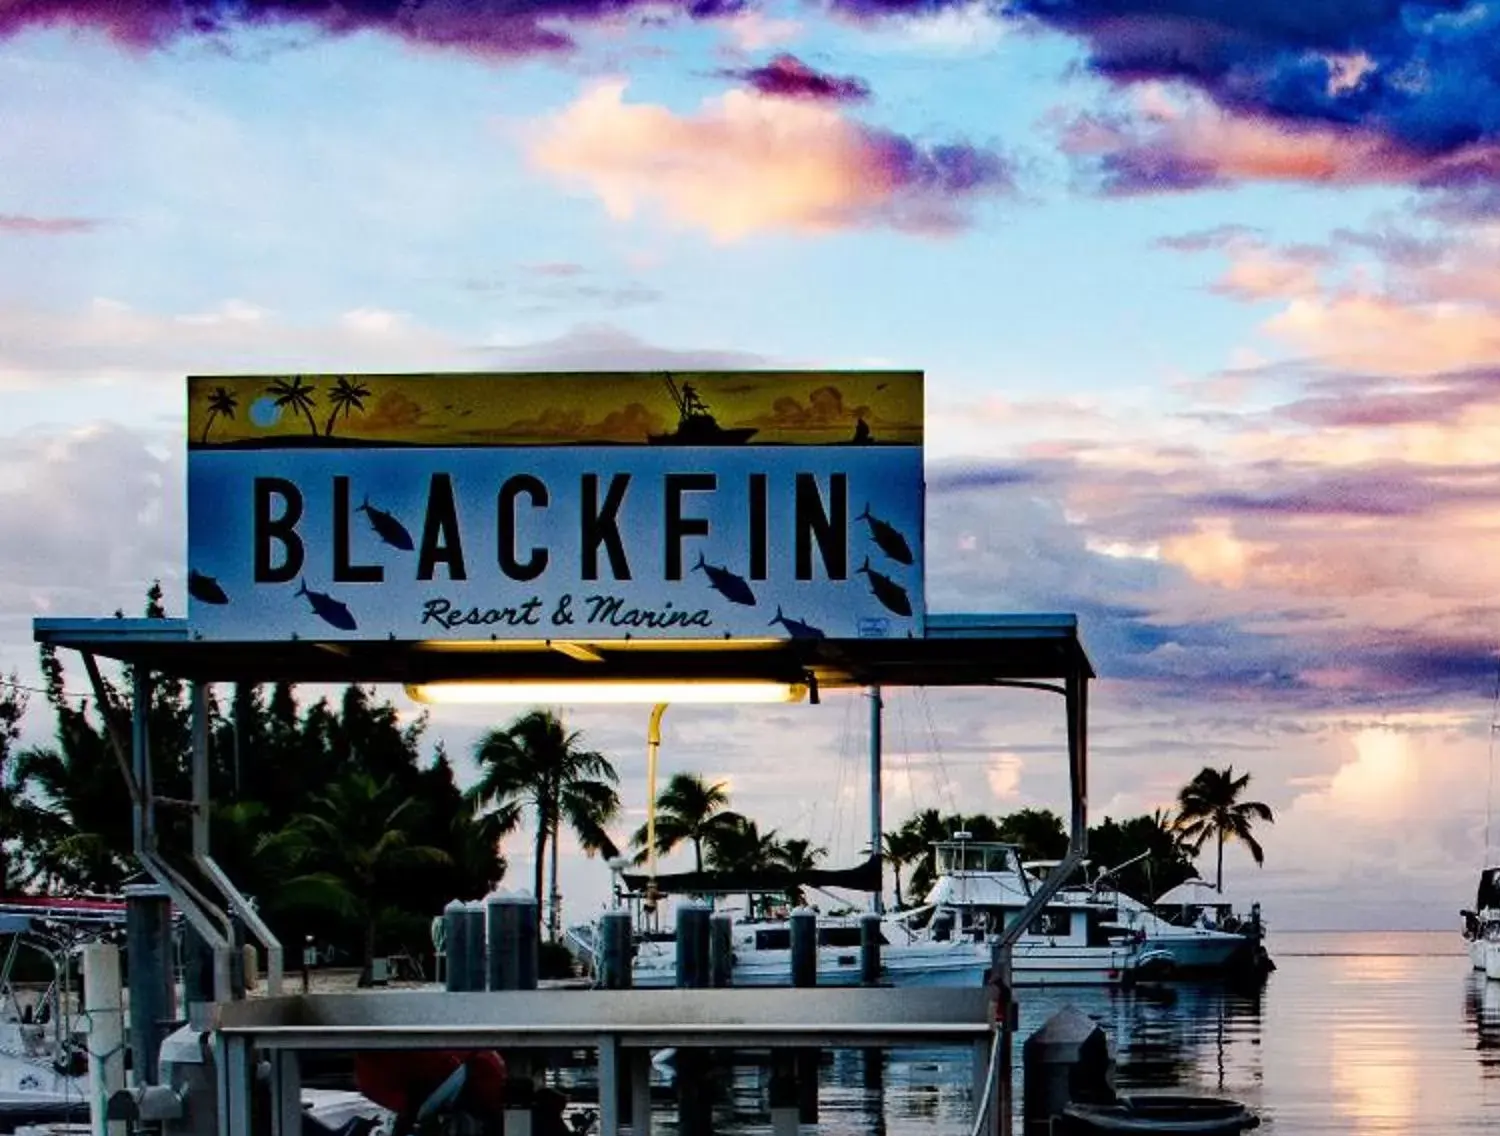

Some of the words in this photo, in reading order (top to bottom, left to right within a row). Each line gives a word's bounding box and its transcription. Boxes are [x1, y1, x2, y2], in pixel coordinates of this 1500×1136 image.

[253, 472, 847, 583] BLACKFIN
[421, 595, 543, 629] Resort
[551, 593, 574, 627] &
[586, 594, 713, 628] Marina
